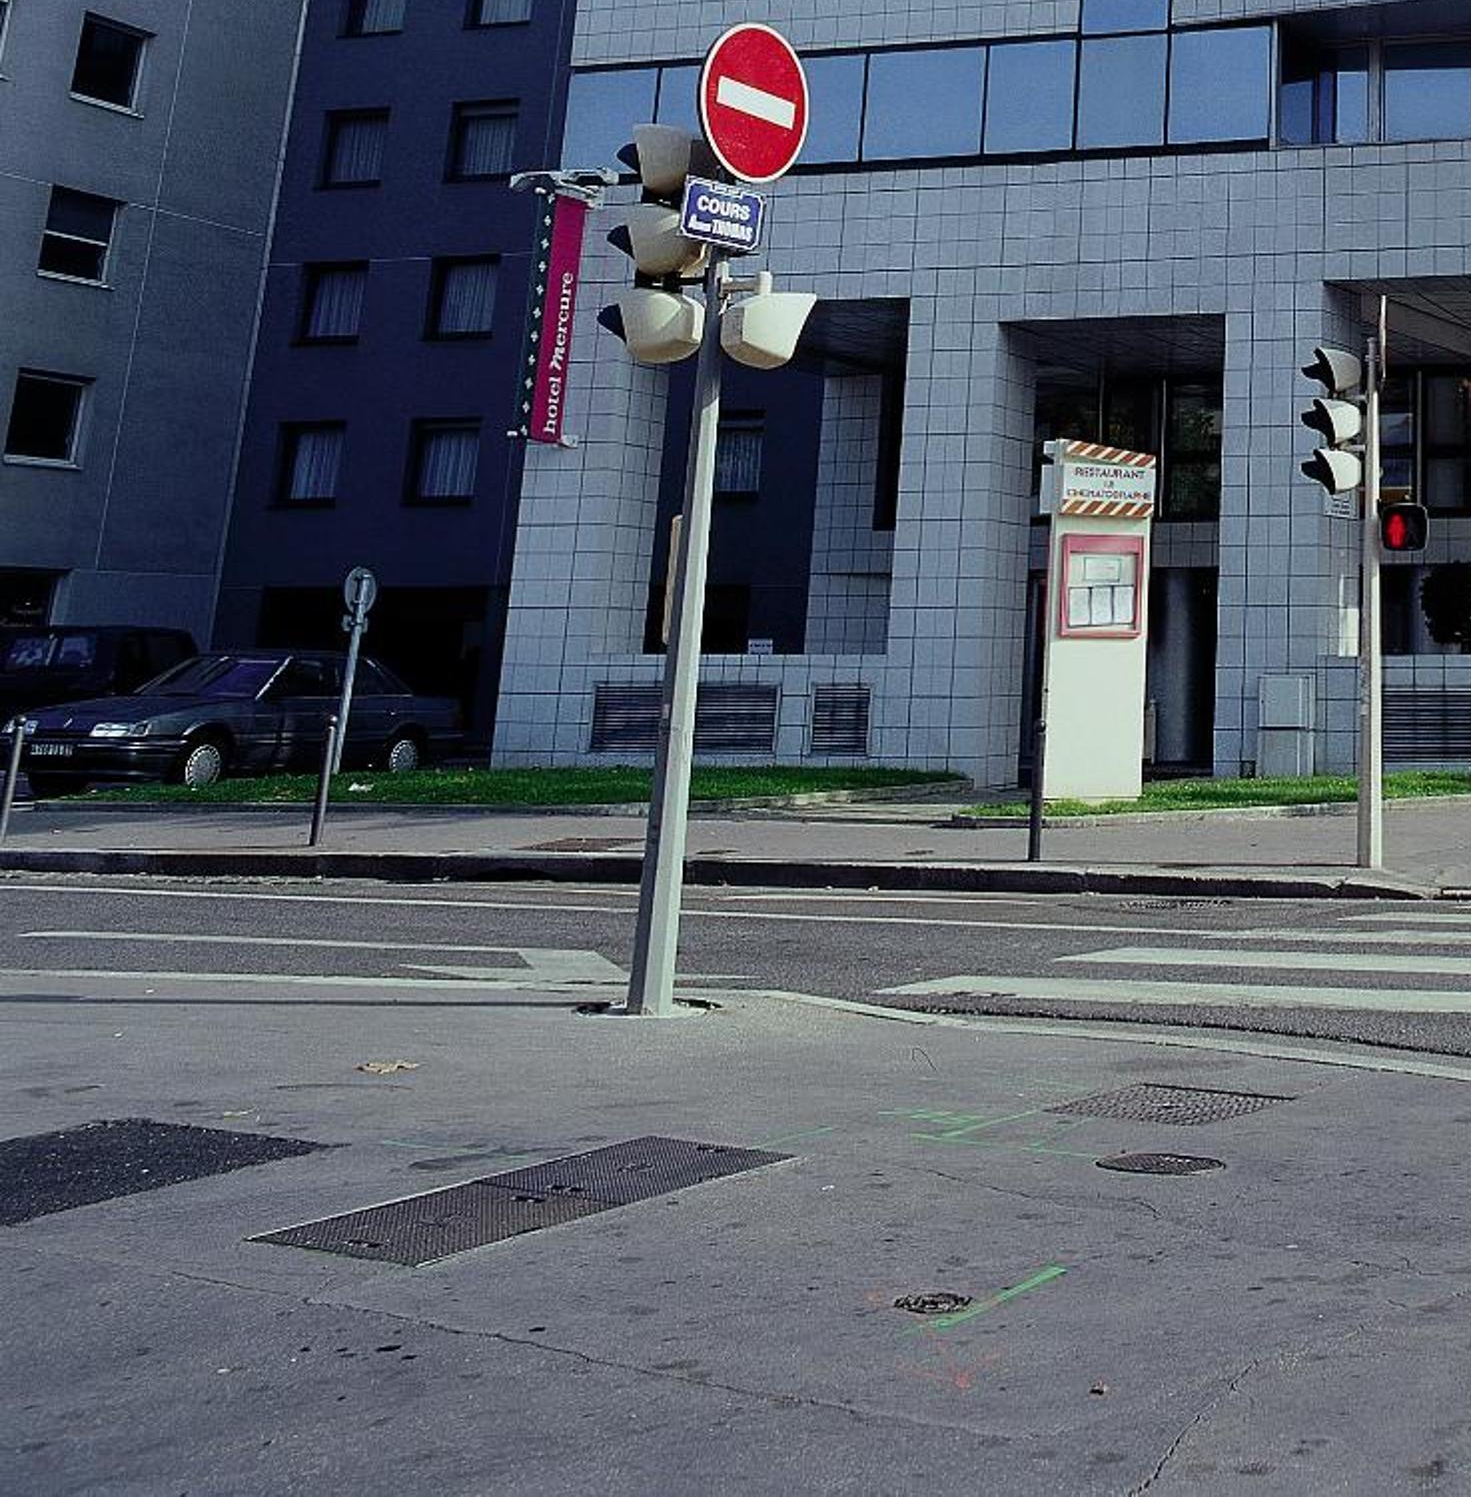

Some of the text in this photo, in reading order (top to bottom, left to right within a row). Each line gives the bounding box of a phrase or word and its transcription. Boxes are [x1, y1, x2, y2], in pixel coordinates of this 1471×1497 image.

[697, 194, 751, 221] COURS
[543, 376, 562, 434] hotel
[1074, 466, 1145, 480] RESTAURANT
